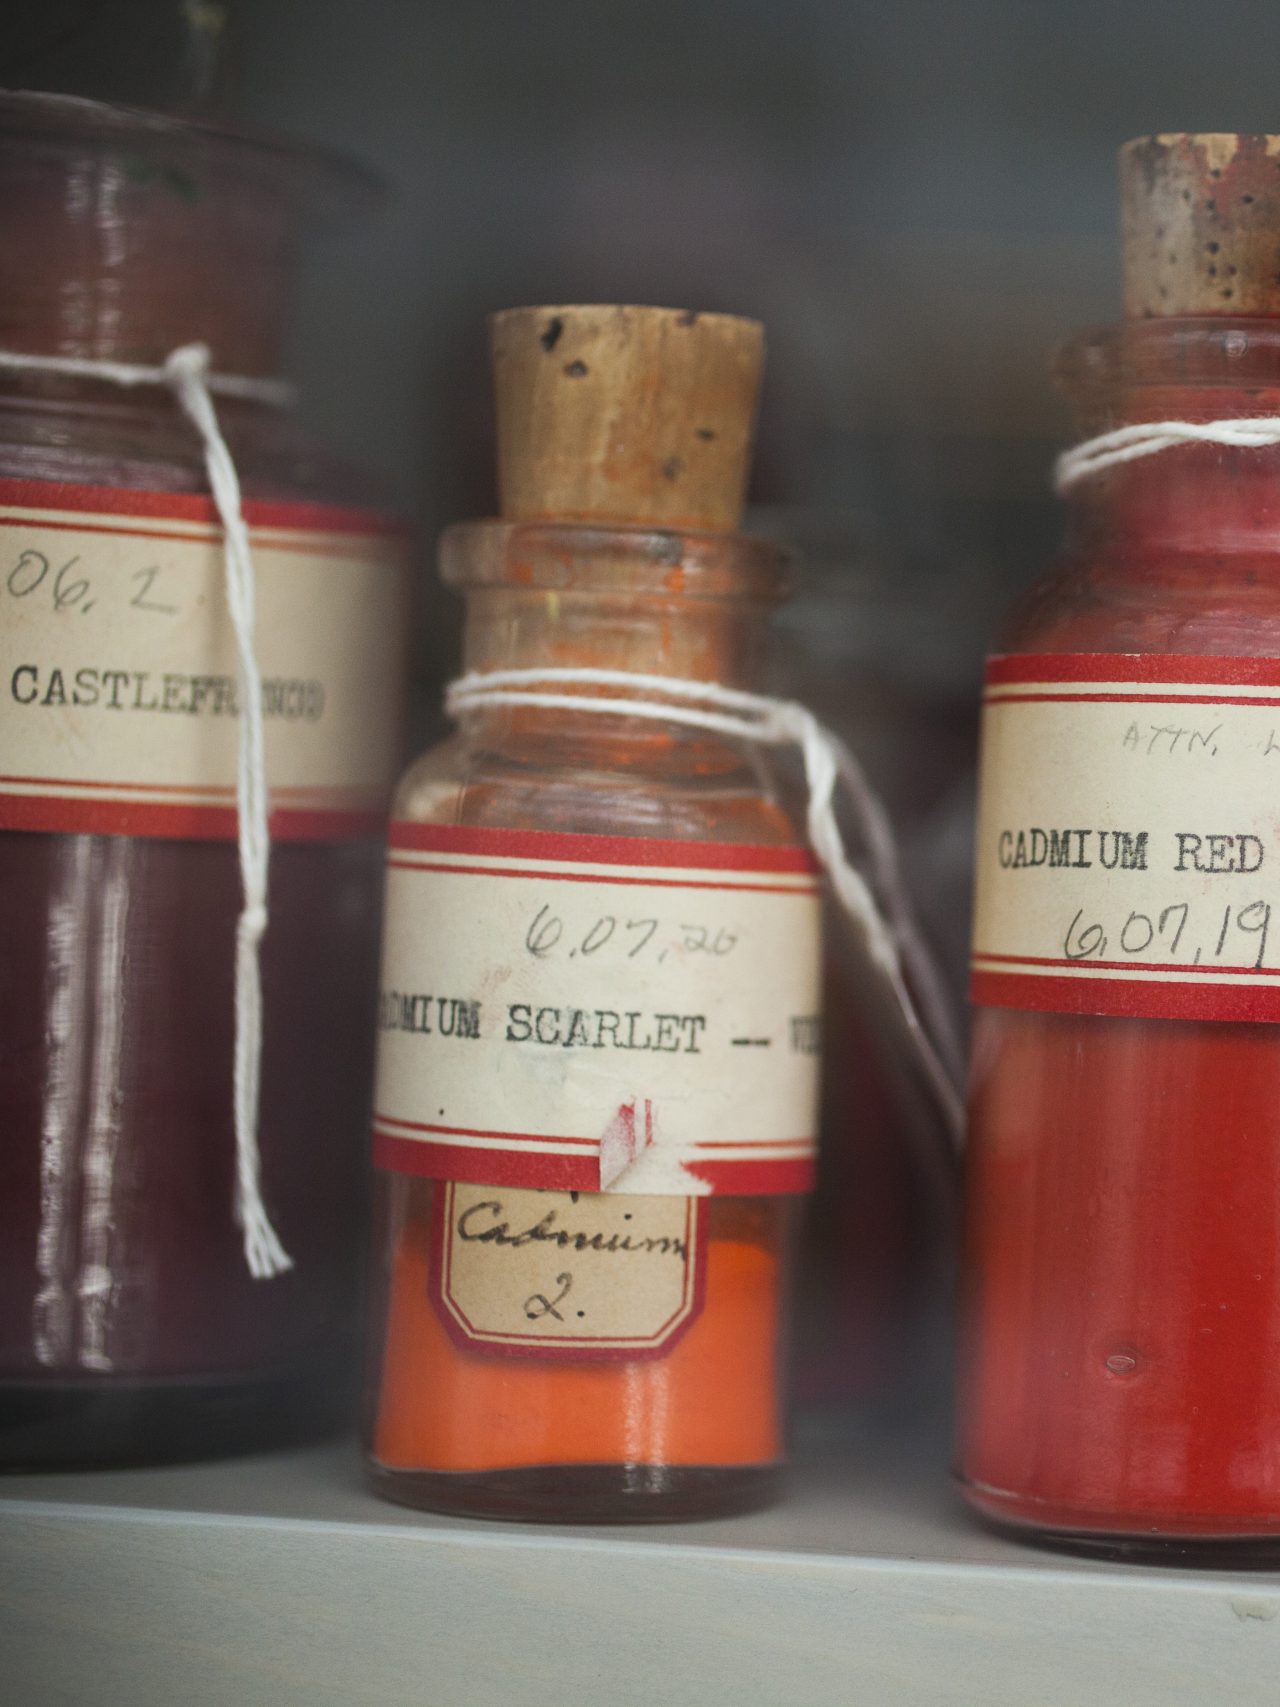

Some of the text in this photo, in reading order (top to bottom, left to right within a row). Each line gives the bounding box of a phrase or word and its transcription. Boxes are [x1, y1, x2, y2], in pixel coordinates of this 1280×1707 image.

[999, 828, 1150, 872] CADMIUM
[1173, 832, 1266, 875] RED
[505, 1003, 707, 1053] SCARLET
